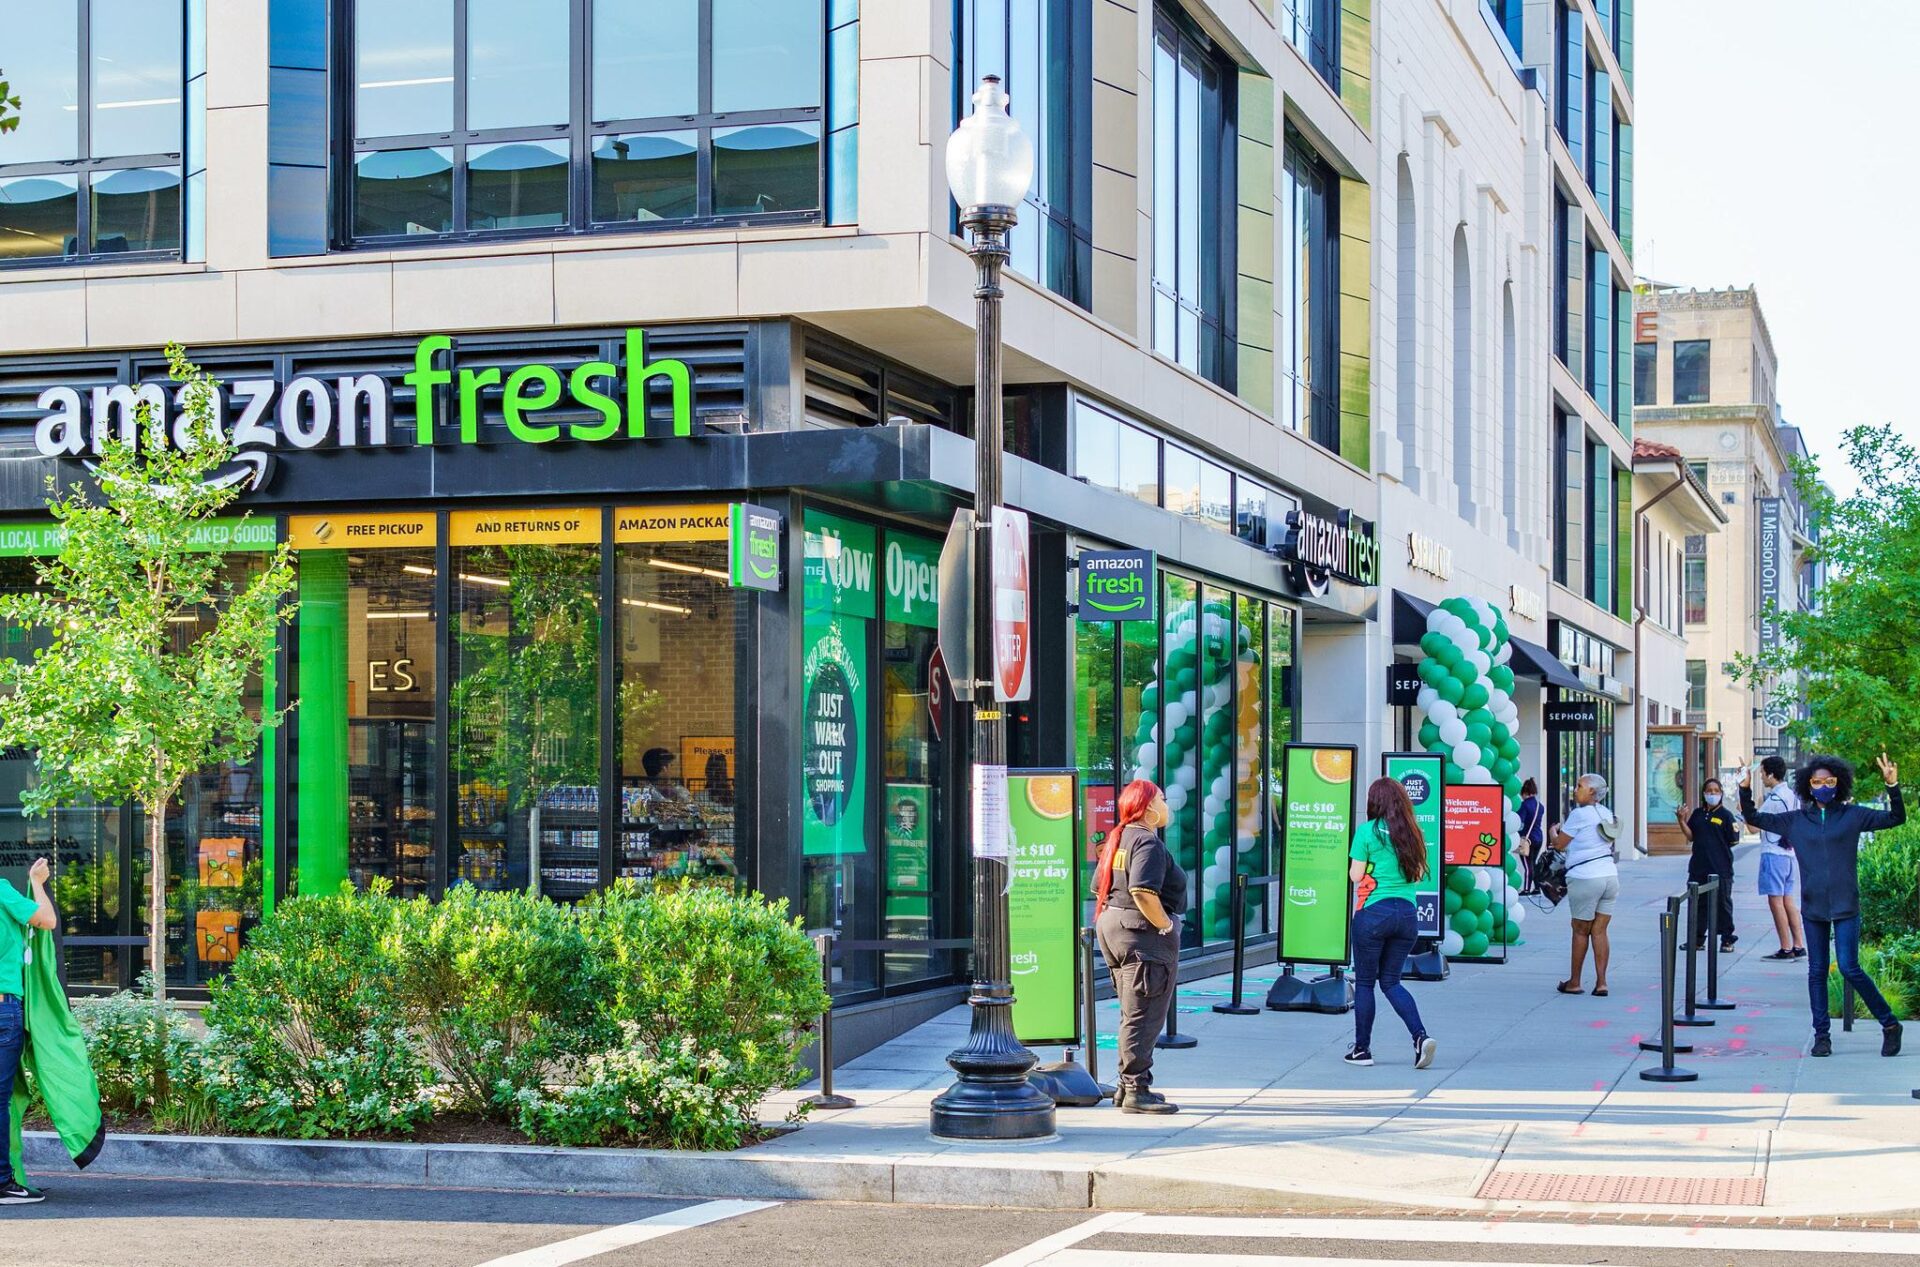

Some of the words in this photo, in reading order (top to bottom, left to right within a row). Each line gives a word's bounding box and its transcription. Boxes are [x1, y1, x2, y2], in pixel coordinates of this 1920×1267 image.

[34, 373, 387, 456] amazon
[404, 328, 692, 445] fresh
[346, 524, 376, 536] FREE
[379, 523, 424, 535] PICKUP
[475, 521, 503, 533] AND
[504, 520, 561, 533] RETURNS
[564, 519, 581, 531] OF
[619, 518, 677, 531] AMAZON
[749, 513, 778, 531] amazon
[1, 530, 40, 550] LOCAL
[234, 524, 277, 543] GOODS
[749, 530, 778, 560] fresh
[1297, 509, 1347, 574] amazon
[1347, 508, 1381, 587] fresh
[820, 526, 874, 593] Now
[1086, 558, 1144, 570] amazon
[1086, 571, 1144, 594] fresh
[369, 659, 413, 691] ES
[817, 692, 844, 718] JUST
[1549, 712, 1595, 721] SEPHORA
[815, 720, 847, 747] WALK
[819, 750, 843, 775] OUT
[815, 778, 845, 793] SHOPPING
[1289, 801, 1311, 812] Get
[1445, 798, 1480, 806] Welcome
[1445, 806, 1469, 815] Logan
[1469, 806, 1493, 814] Circle.
[1289, 821, 1322, 832] every
[1324, 820, 1346, 833] day
[1012, 867, 1042, 880] very
[1043, 865, 1069, 880] day
[1289, 886, 1316, 898] fresh
[1011, 951, 1037, 964] resh
